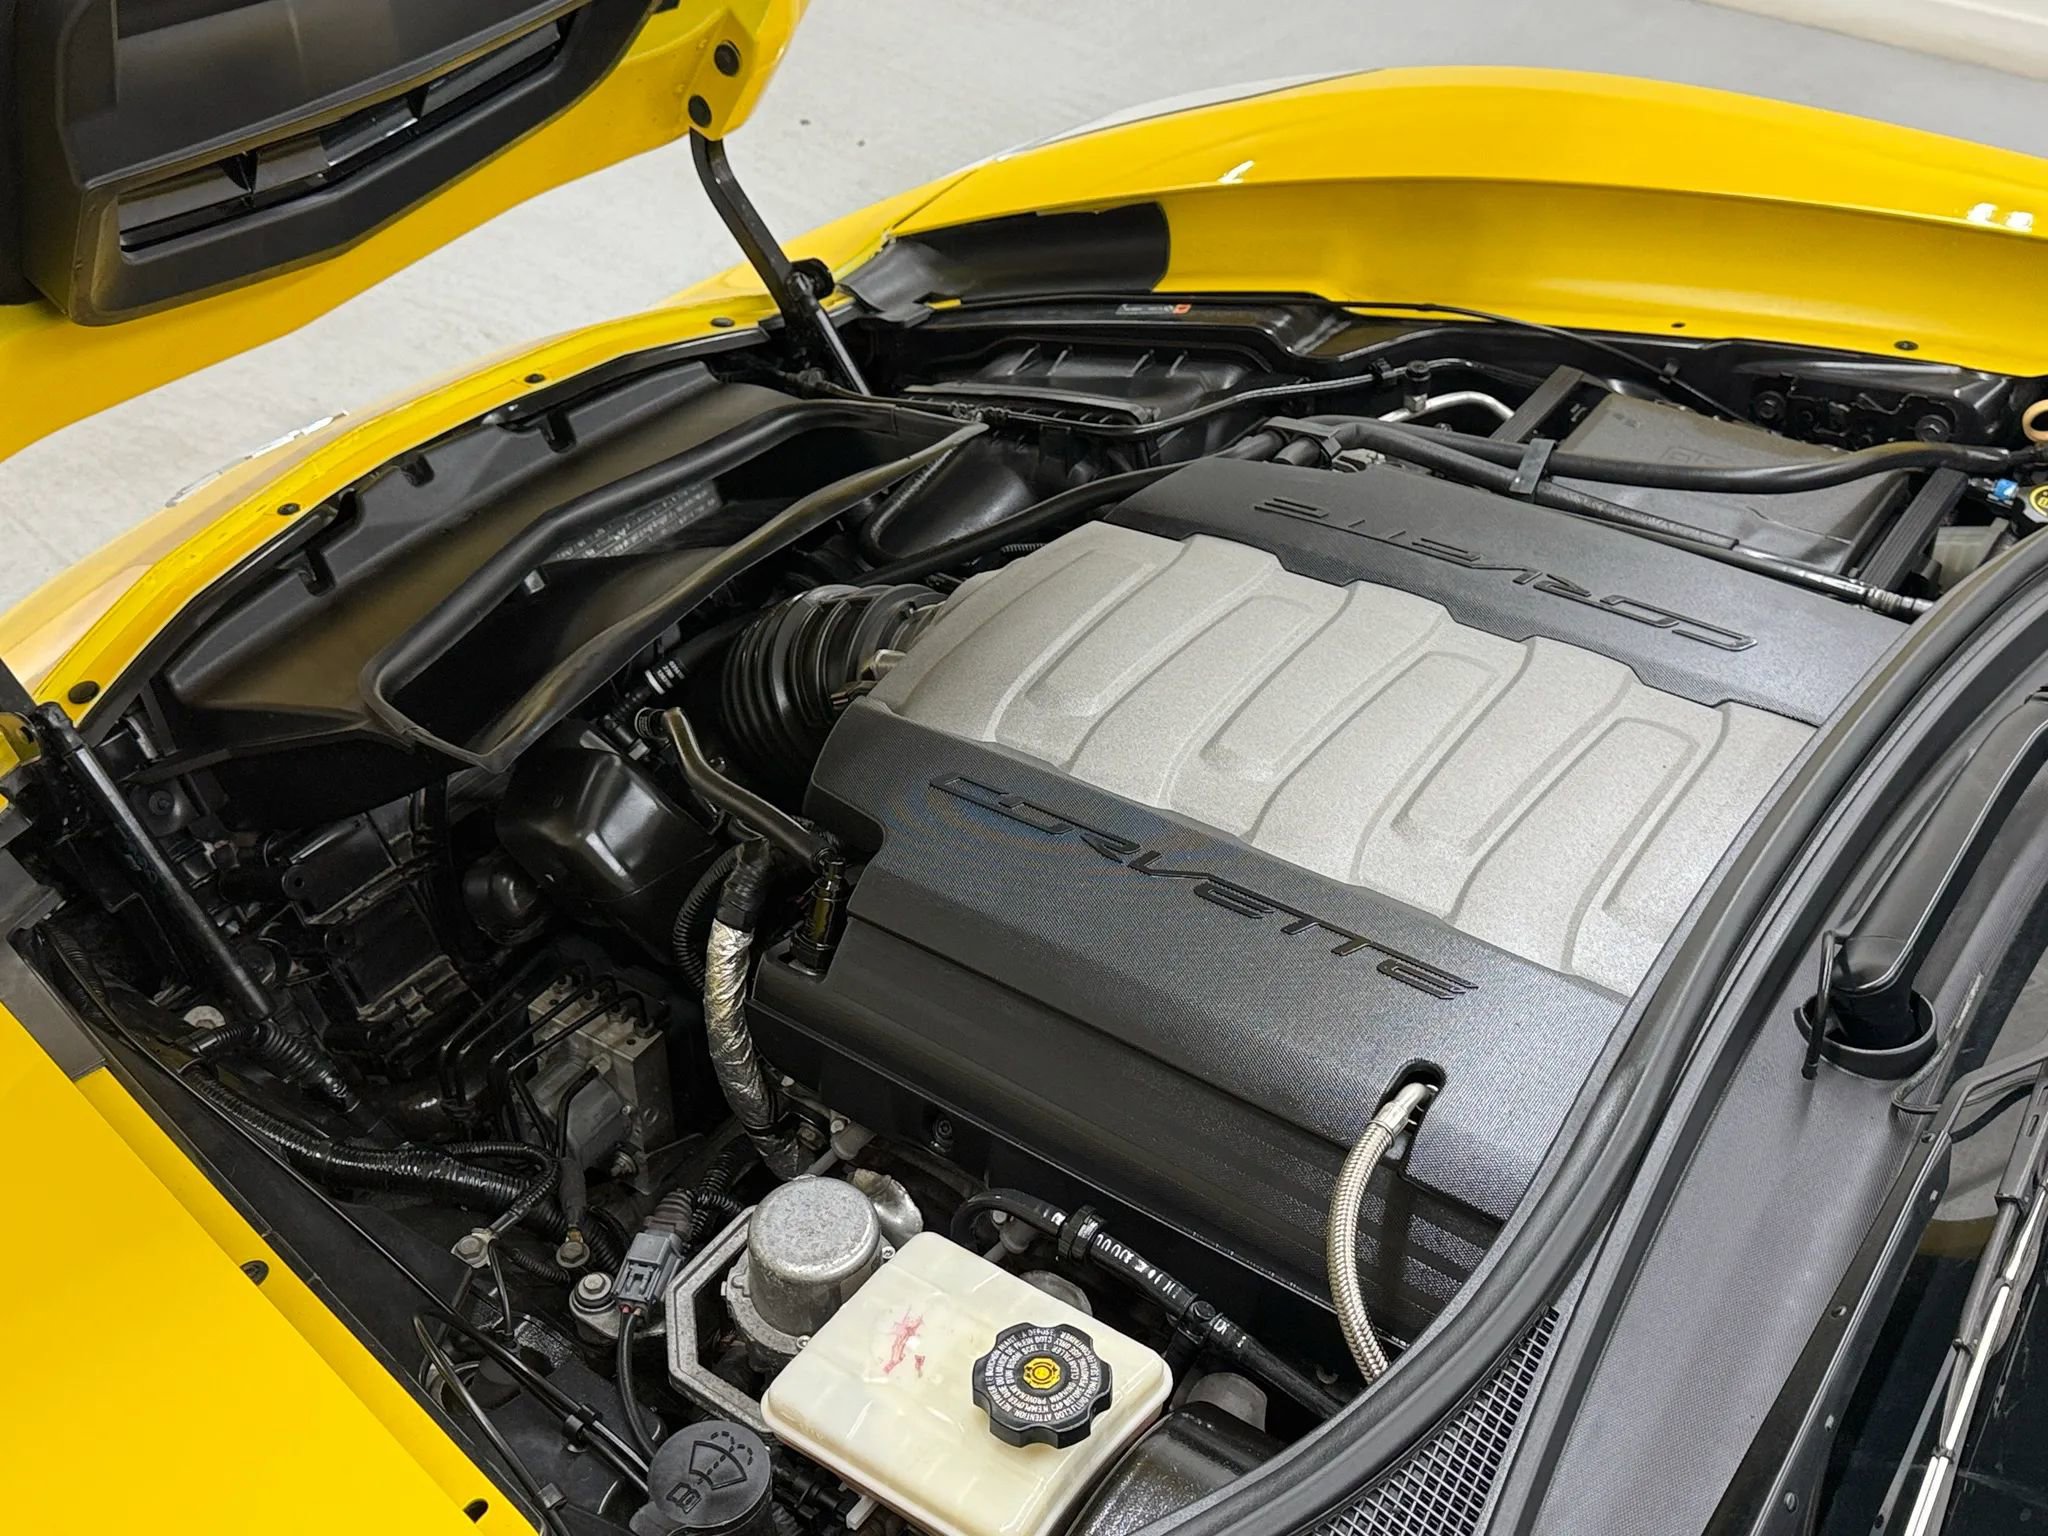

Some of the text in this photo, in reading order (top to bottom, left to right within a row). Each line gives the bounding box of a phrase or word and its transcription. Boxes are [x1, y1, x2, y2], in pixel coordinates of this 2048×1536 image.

[1254, 498, 1757, 651] CORVETTE
[929, 775, 1479, 1001] CORVETTE
[1050, 1400, 1065, 1411] CAP
